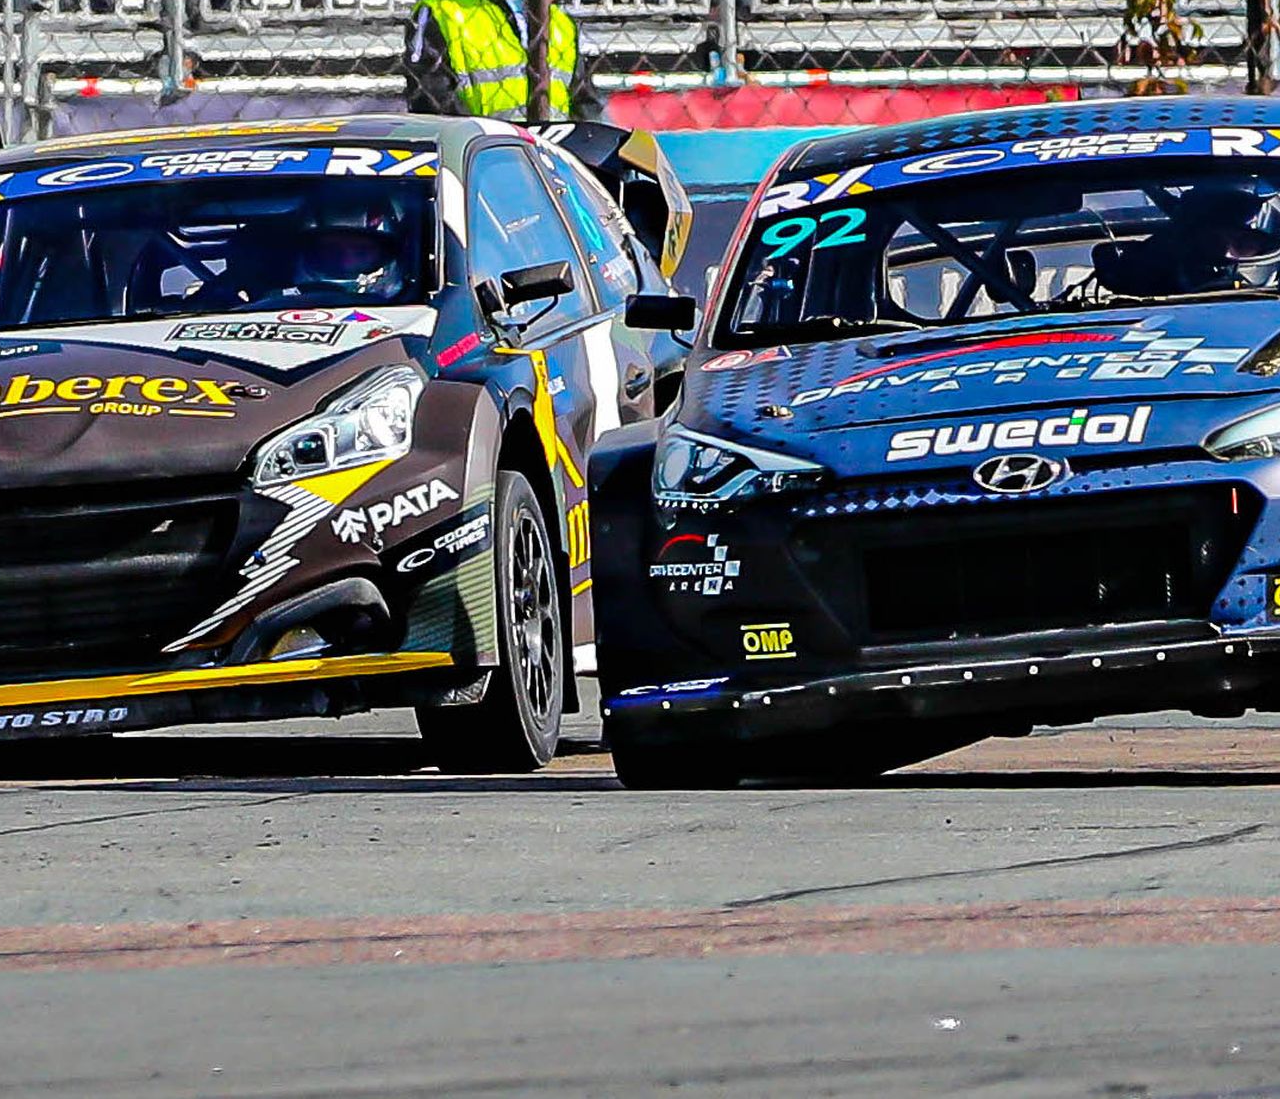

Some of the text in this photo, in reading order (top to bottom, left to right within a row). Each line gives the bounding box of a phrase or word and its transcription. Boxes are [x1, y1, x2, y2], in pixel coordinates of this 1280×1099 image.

[1011, 131, 1187, 155] COOPER
[1034, 143, 1160, 162] TIRES
[141, 150, 308, 167] COOPER
[161, 161, 277, 177] TIRES
[324, 147, 438, 176] RX
[758, 163, 874, 218] RX
[761, 207, 867, 260] 92
[179, 329, 332, 342] SOLUTION
[789, 349, 1181, 407] DRIVECENTER
[89, 402, 161, 416] GROUP
[885, 405, 1153, 462] swedol
[368, 478, 460, 533] PATA
[433, 513, 489, 549] COOPER
[446, 527, 487, 553] TIRES
[743, 629, 794, 653] OMP
